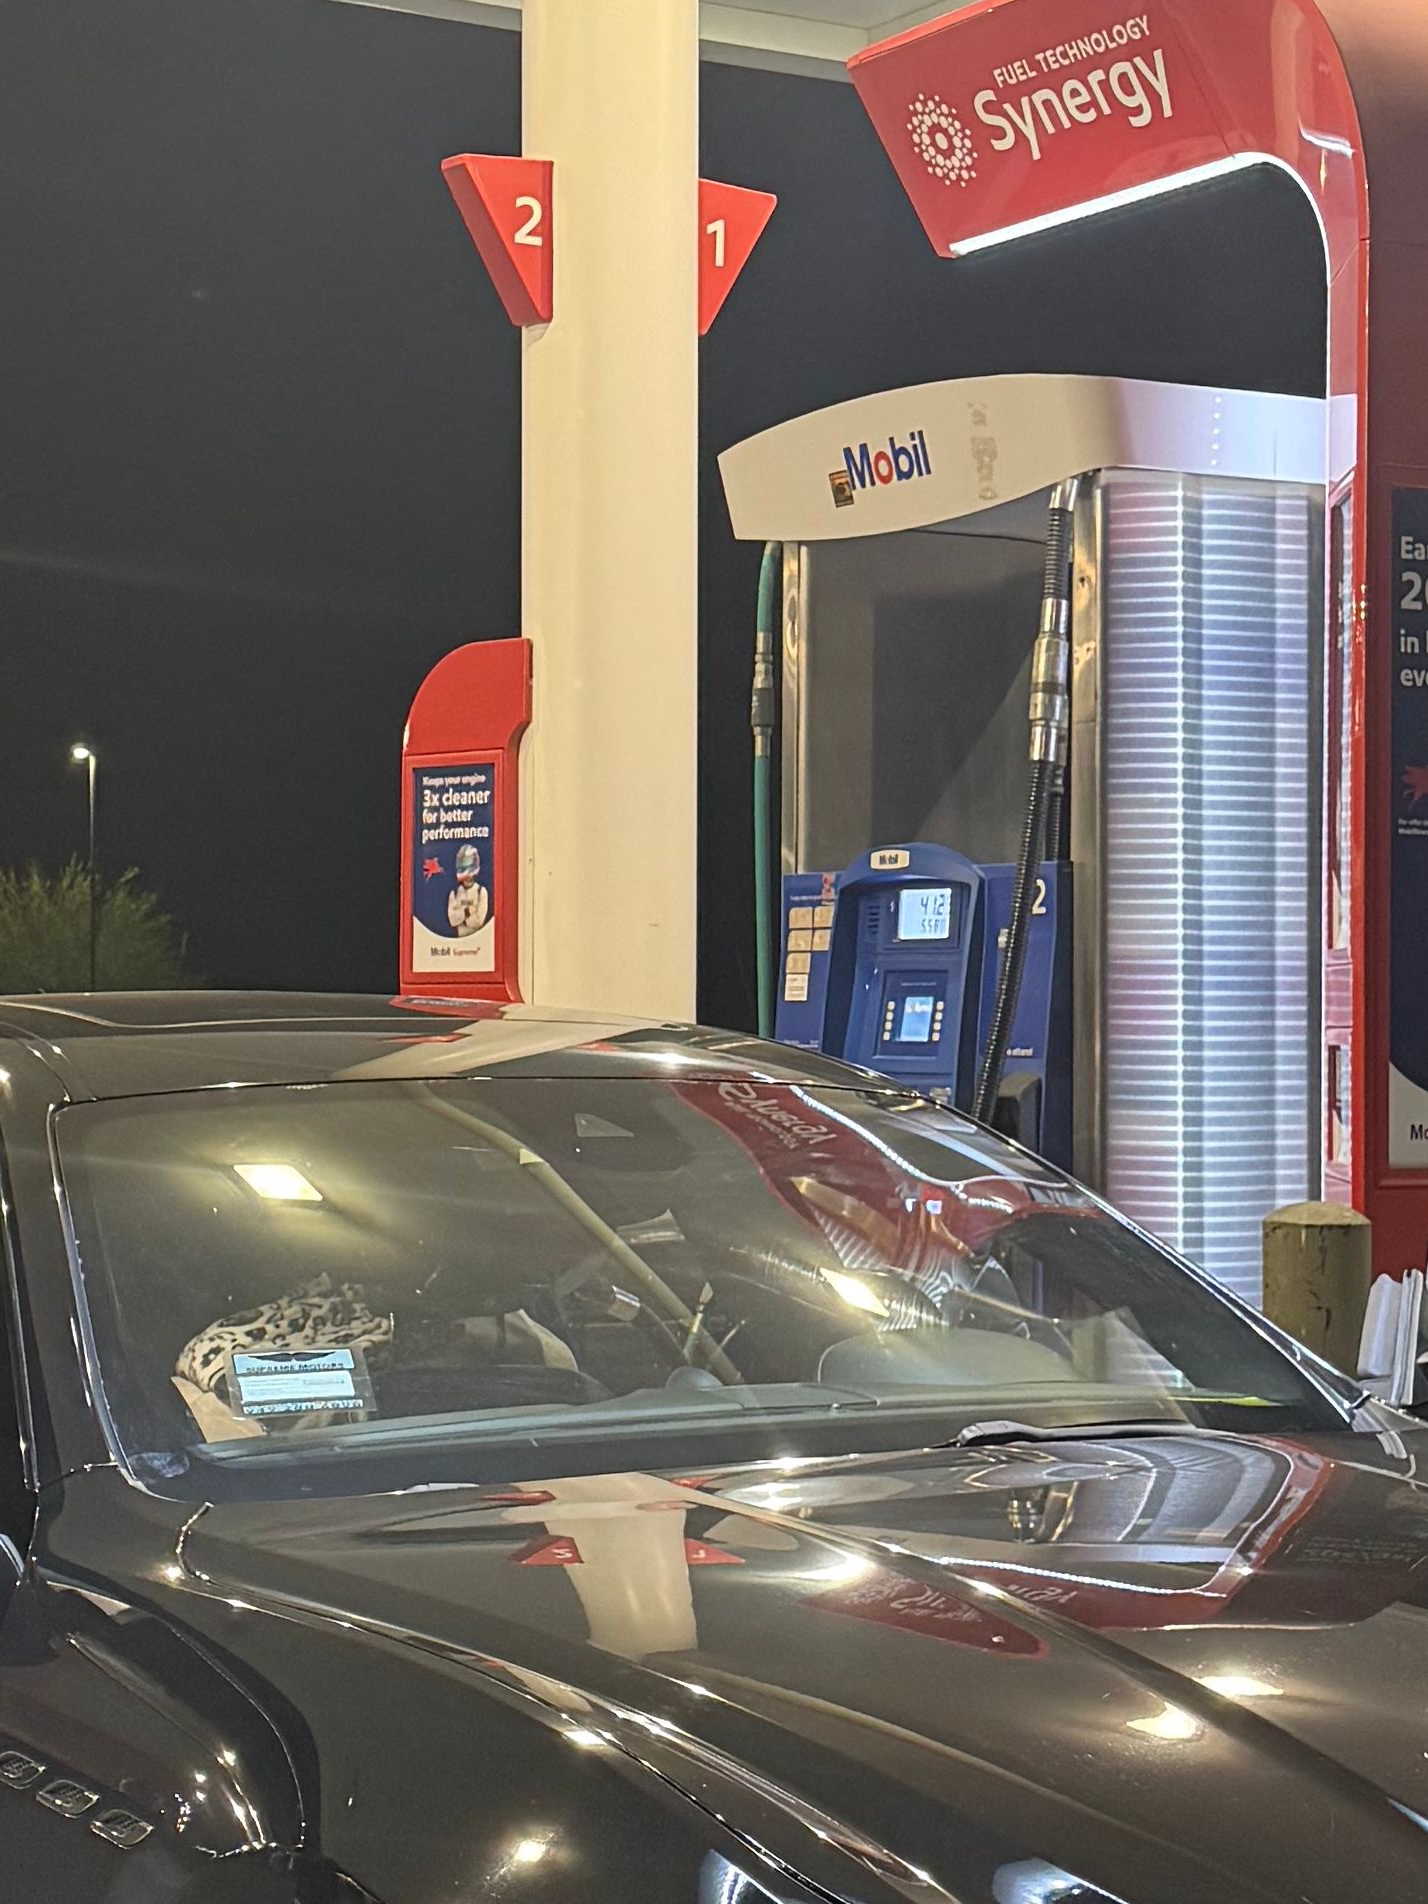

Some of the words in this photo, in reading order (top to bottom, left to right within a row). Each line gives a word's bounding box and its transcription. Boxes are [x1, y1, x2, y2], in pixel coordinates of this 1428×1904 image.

[992, 59, 1037, 89] FUEL
[1034, 14, 1151, 73] TECHNOLOGY
[973, 48, 1173, 161] Synergy
[513, 195, 543, 247] 2
[705, 218, 725, 267] 1
[842, 429, 932, 491] Mobil
[1400, 628, 1420, 654] in
[422, 789, 440, 807] 3x
[441, 787, 491, 806] cleaner
[422, 808, 438, 824] for
[439, 807, 474, 823] better
[421, 824, 490, 844] performance
[1031, 878, 1047, 915] 2
